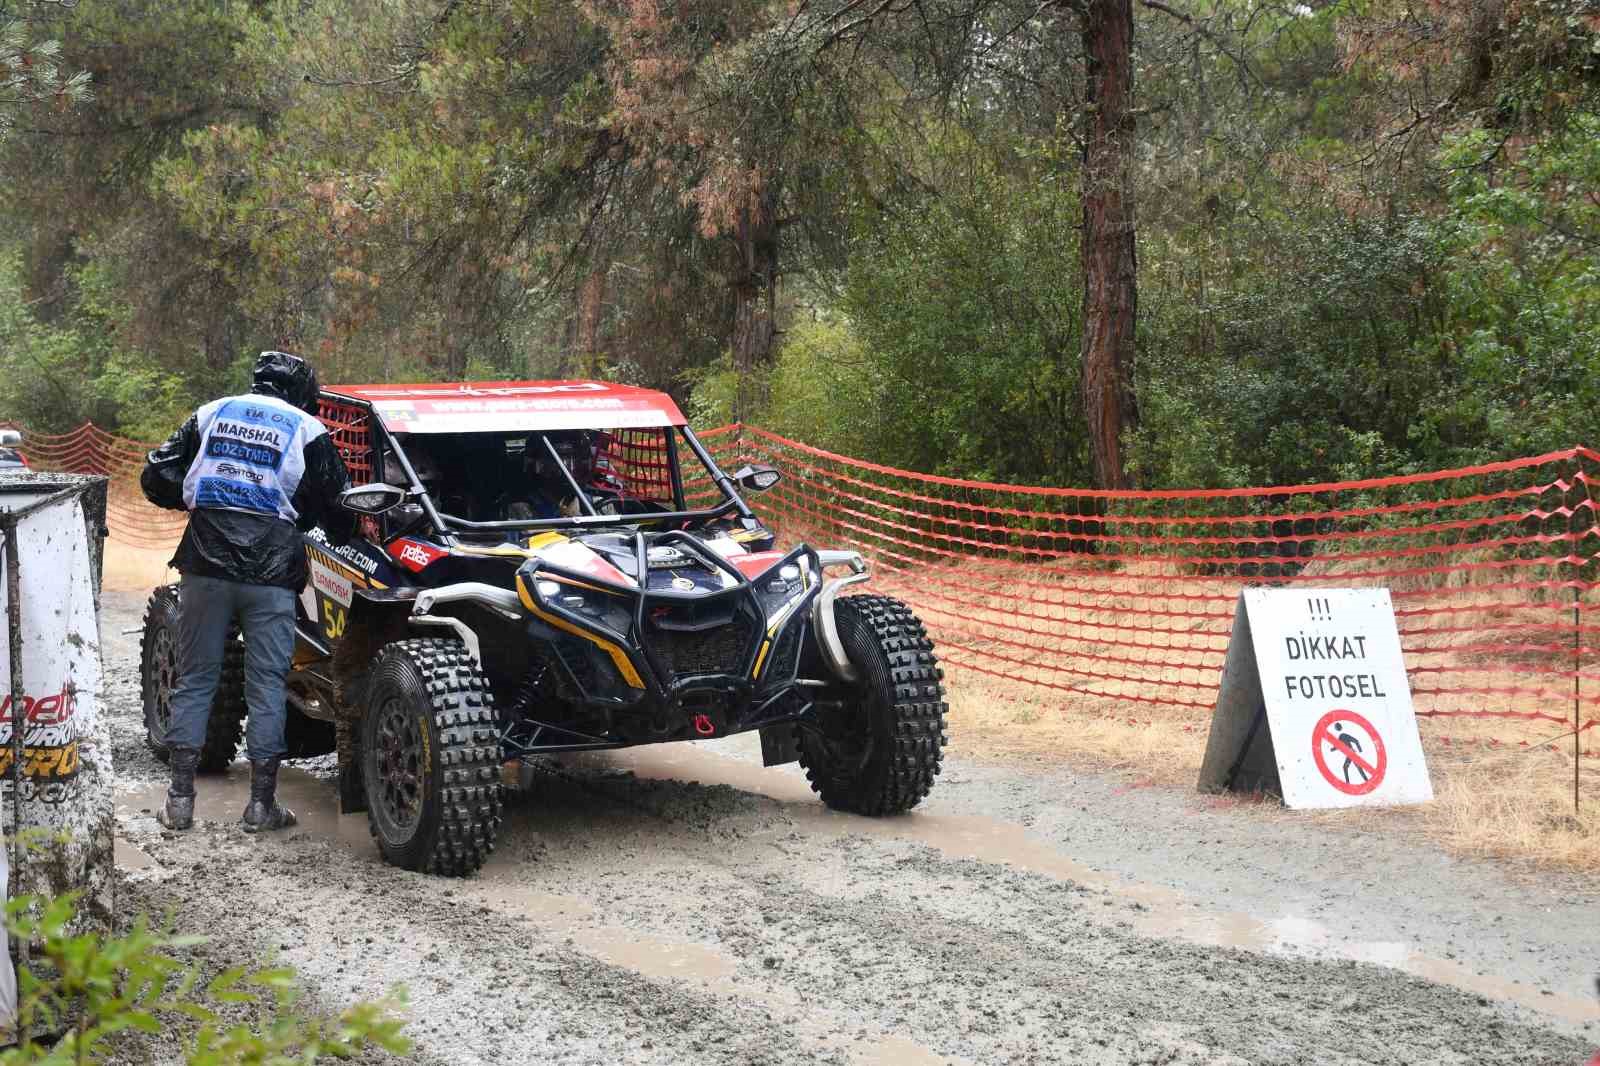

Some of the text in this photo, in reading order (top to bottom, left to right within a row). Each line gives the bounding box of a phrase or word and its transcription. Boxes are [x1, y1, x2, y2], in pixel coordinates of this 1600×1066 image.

[216, 422, 280, 447] MARSHAL
[400, 544, 431, 566] petlas
[323, 599, 345, 639] 54
[1285, 630, 1366, 660] DİKKAT
[1285, 674, 1386, 699] FOTOSEL
